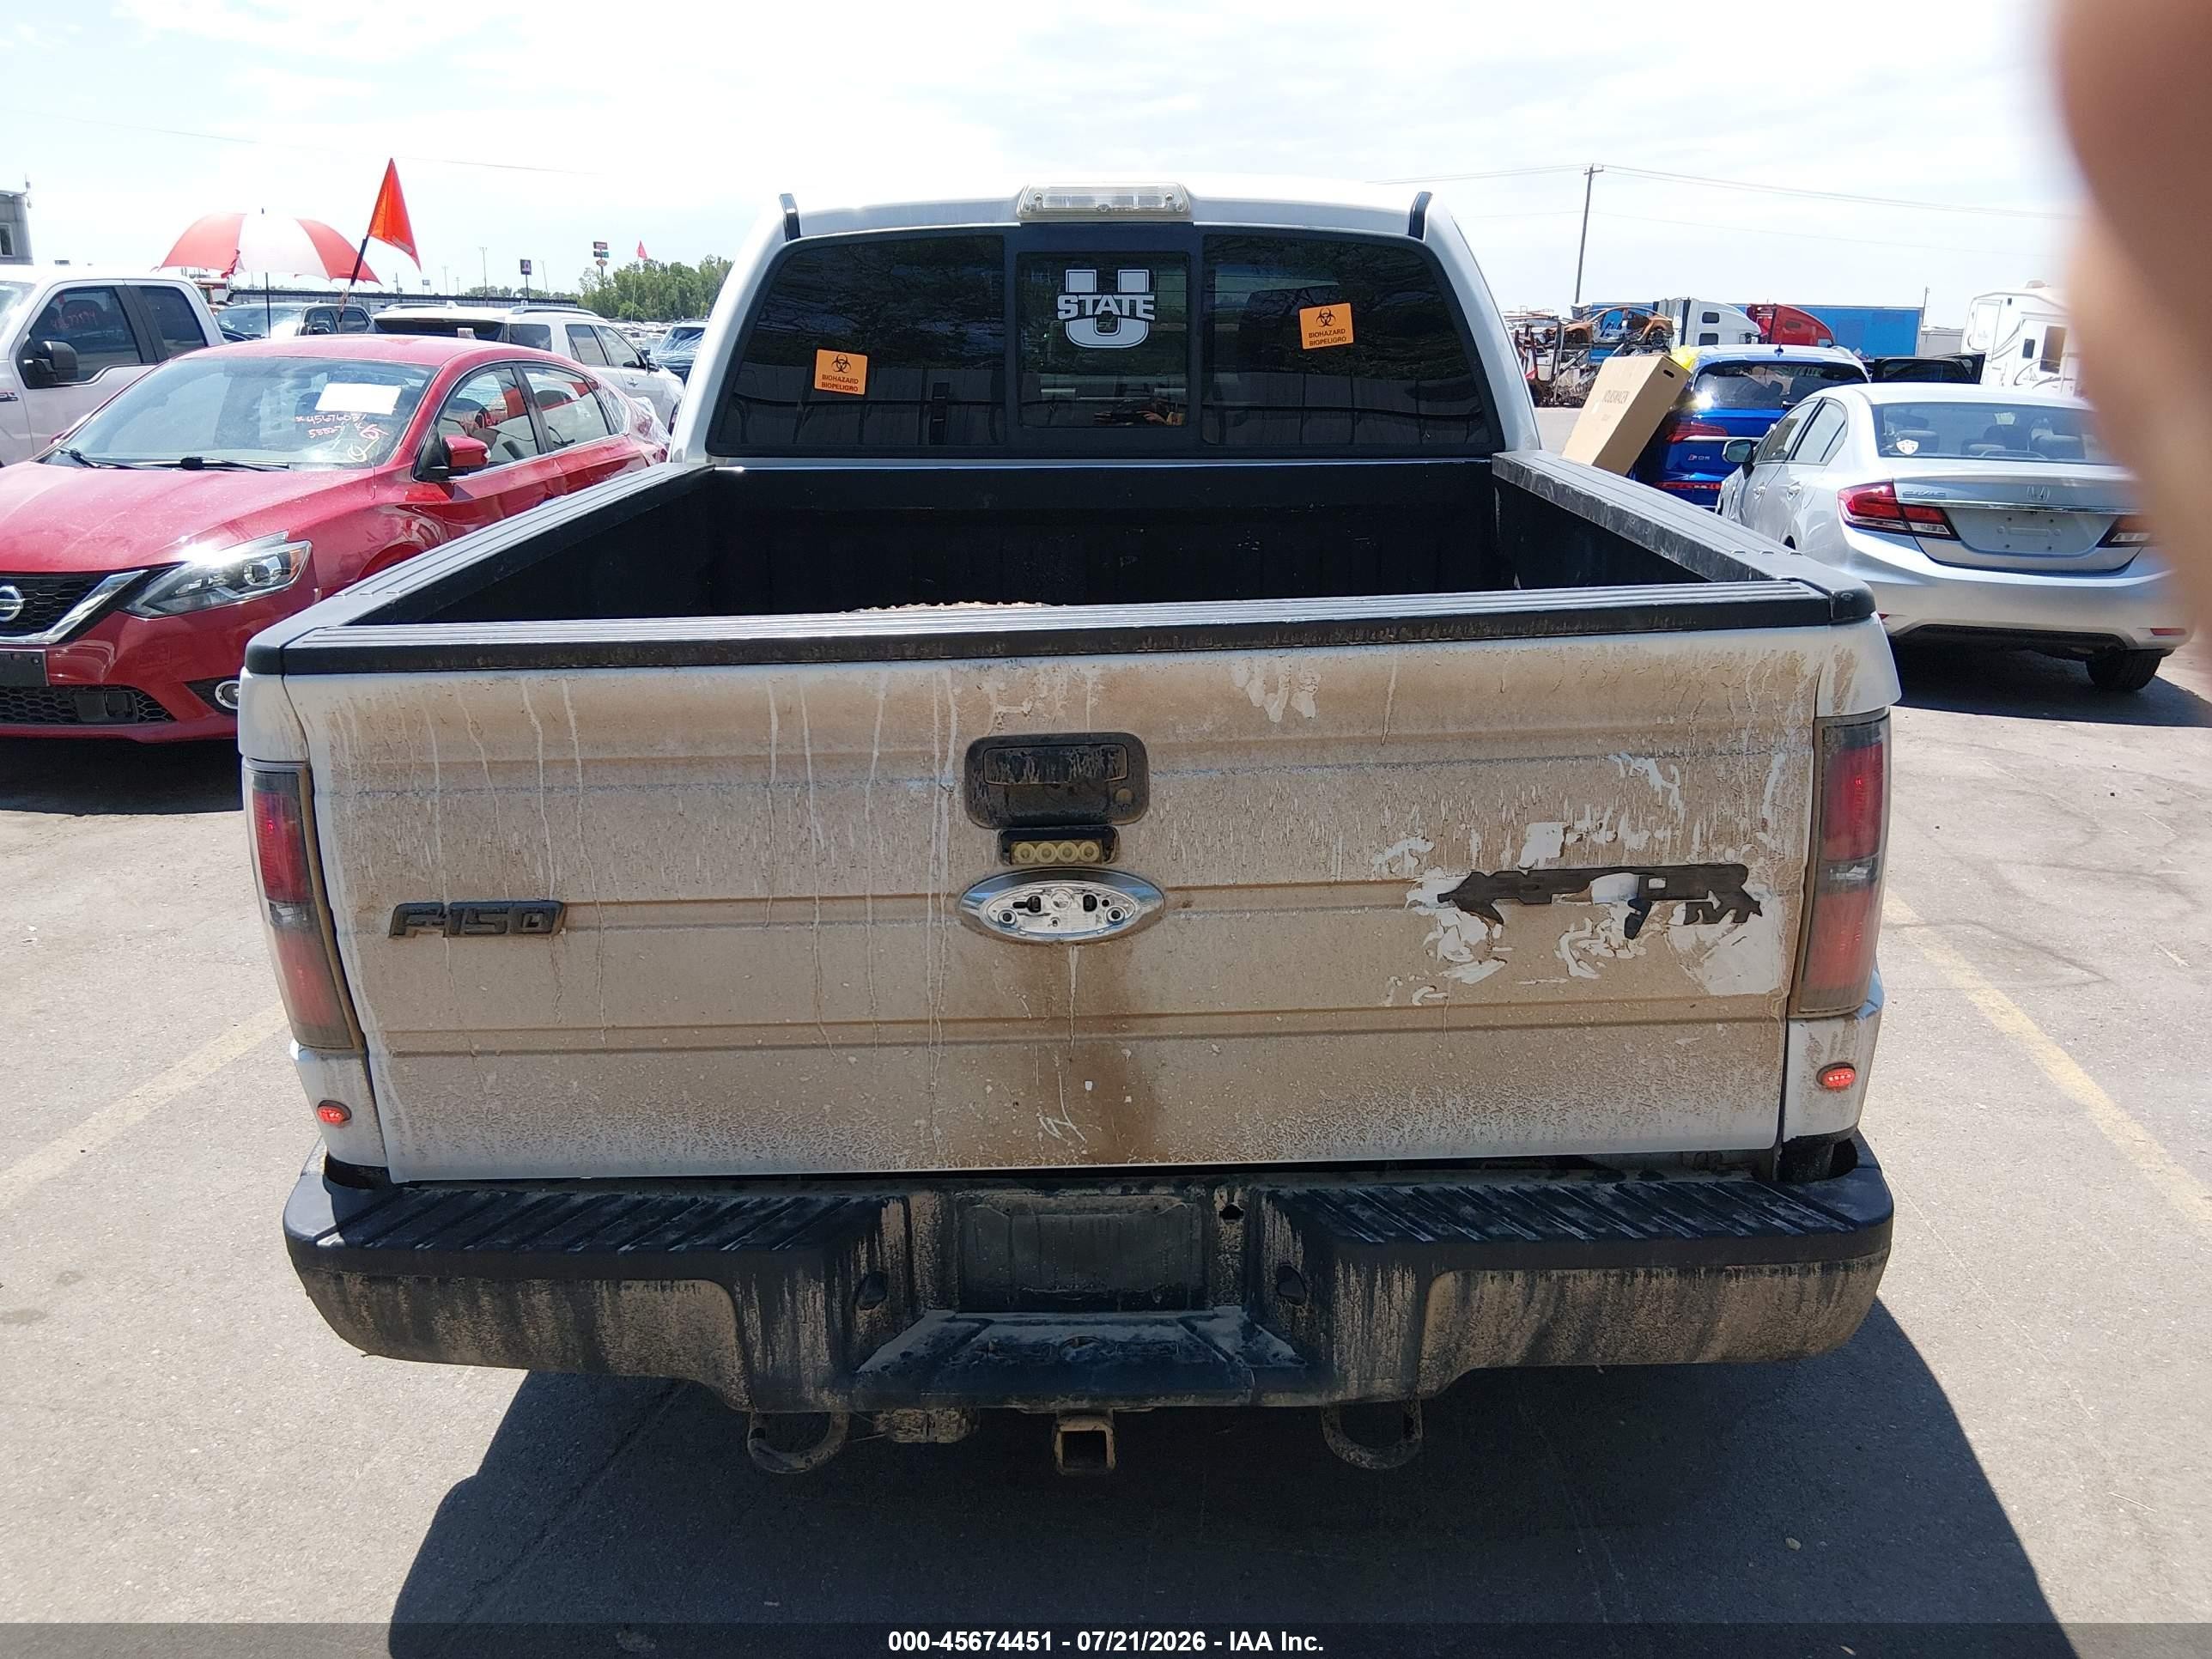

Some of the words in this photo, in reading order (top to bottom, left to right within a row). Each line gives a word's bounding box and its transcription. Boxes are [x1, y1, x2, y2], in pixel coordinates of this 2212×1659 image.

[1057, 295, 1155, 320] STATE
[1308, 328, 1346, 338] BIOHAZARD
[1309, 336, 1346, 346] BIOPELIGRO
[822, 374, 859, 384] BIOHAZARD
[821, 381, 859, 392] BIOPELIGRO
[389, 900, 566, 938] F-150
